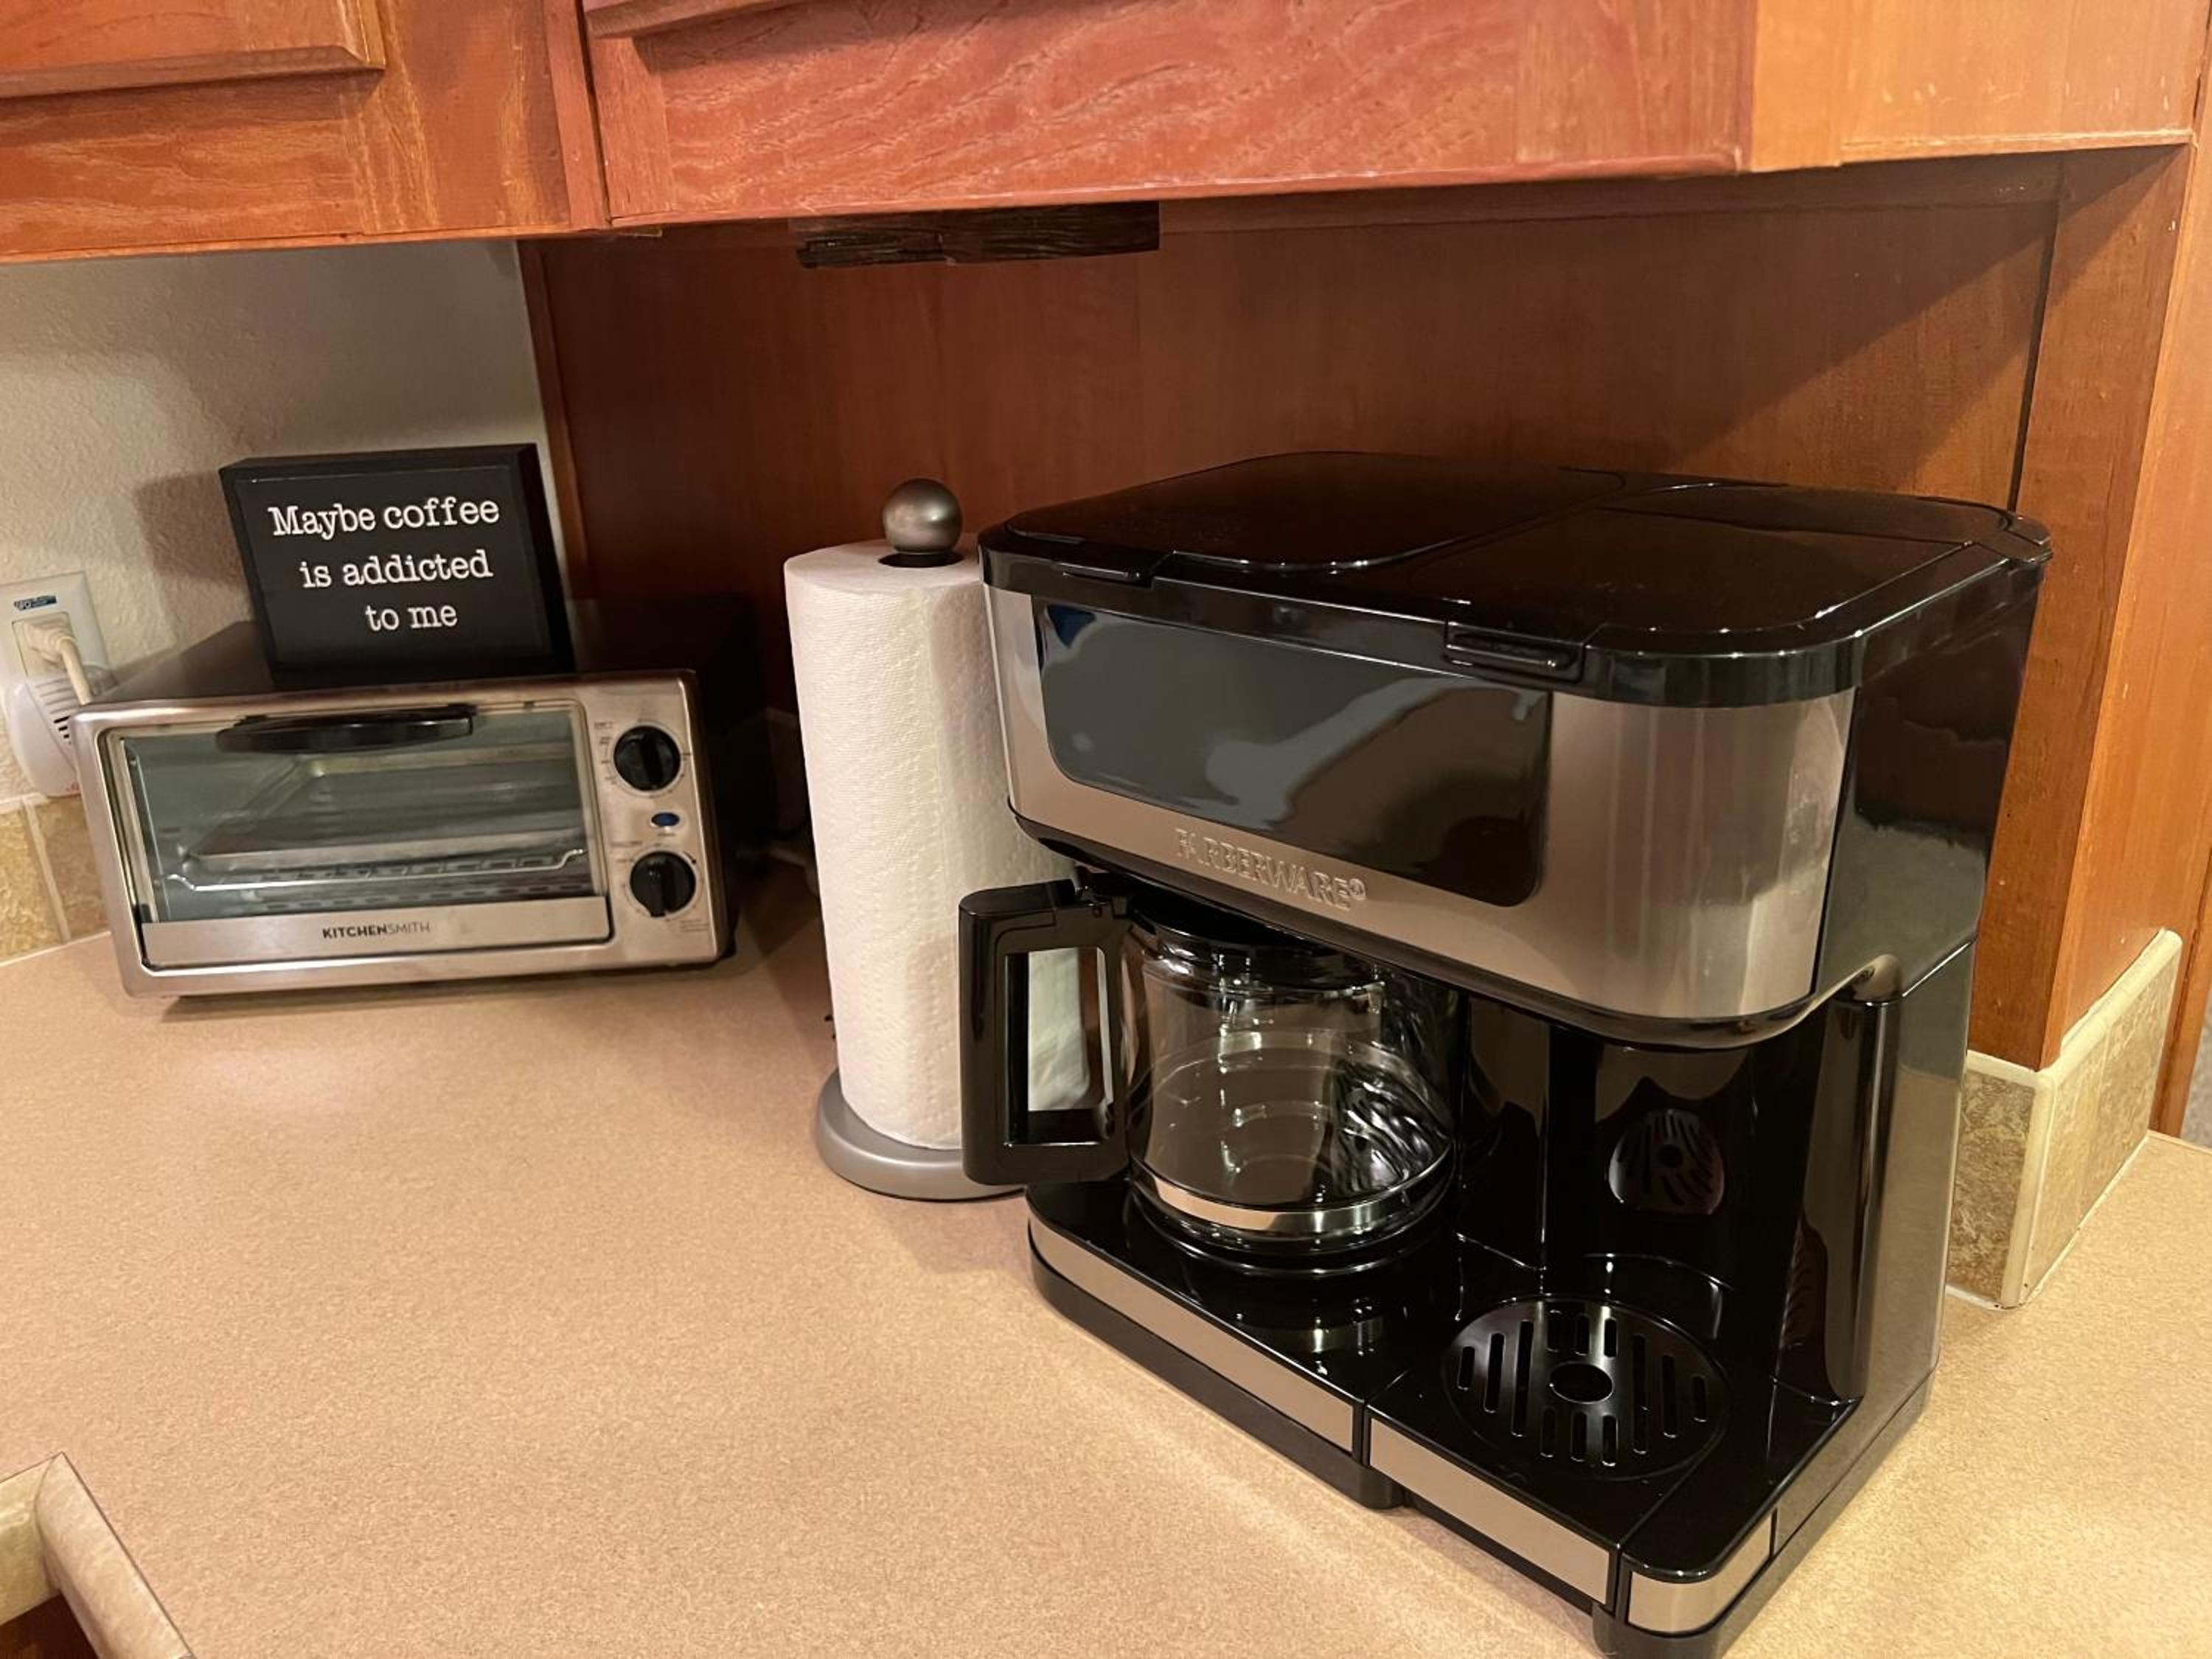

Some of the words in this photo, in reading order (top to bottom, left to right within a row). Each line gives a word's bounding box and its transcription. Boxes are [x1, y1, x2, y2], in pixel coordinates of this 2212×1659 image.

[267, 503, 376, 540] Maybe
[383, 495, 500, 529] coffee
[299, 561, 332, 588] is
[342, 549, 493, 586] addicted
[365, 605, 399, 631] to
[407, 605, 458, 629] me
[322, 921, 431, 939] KITCHENSMITH
